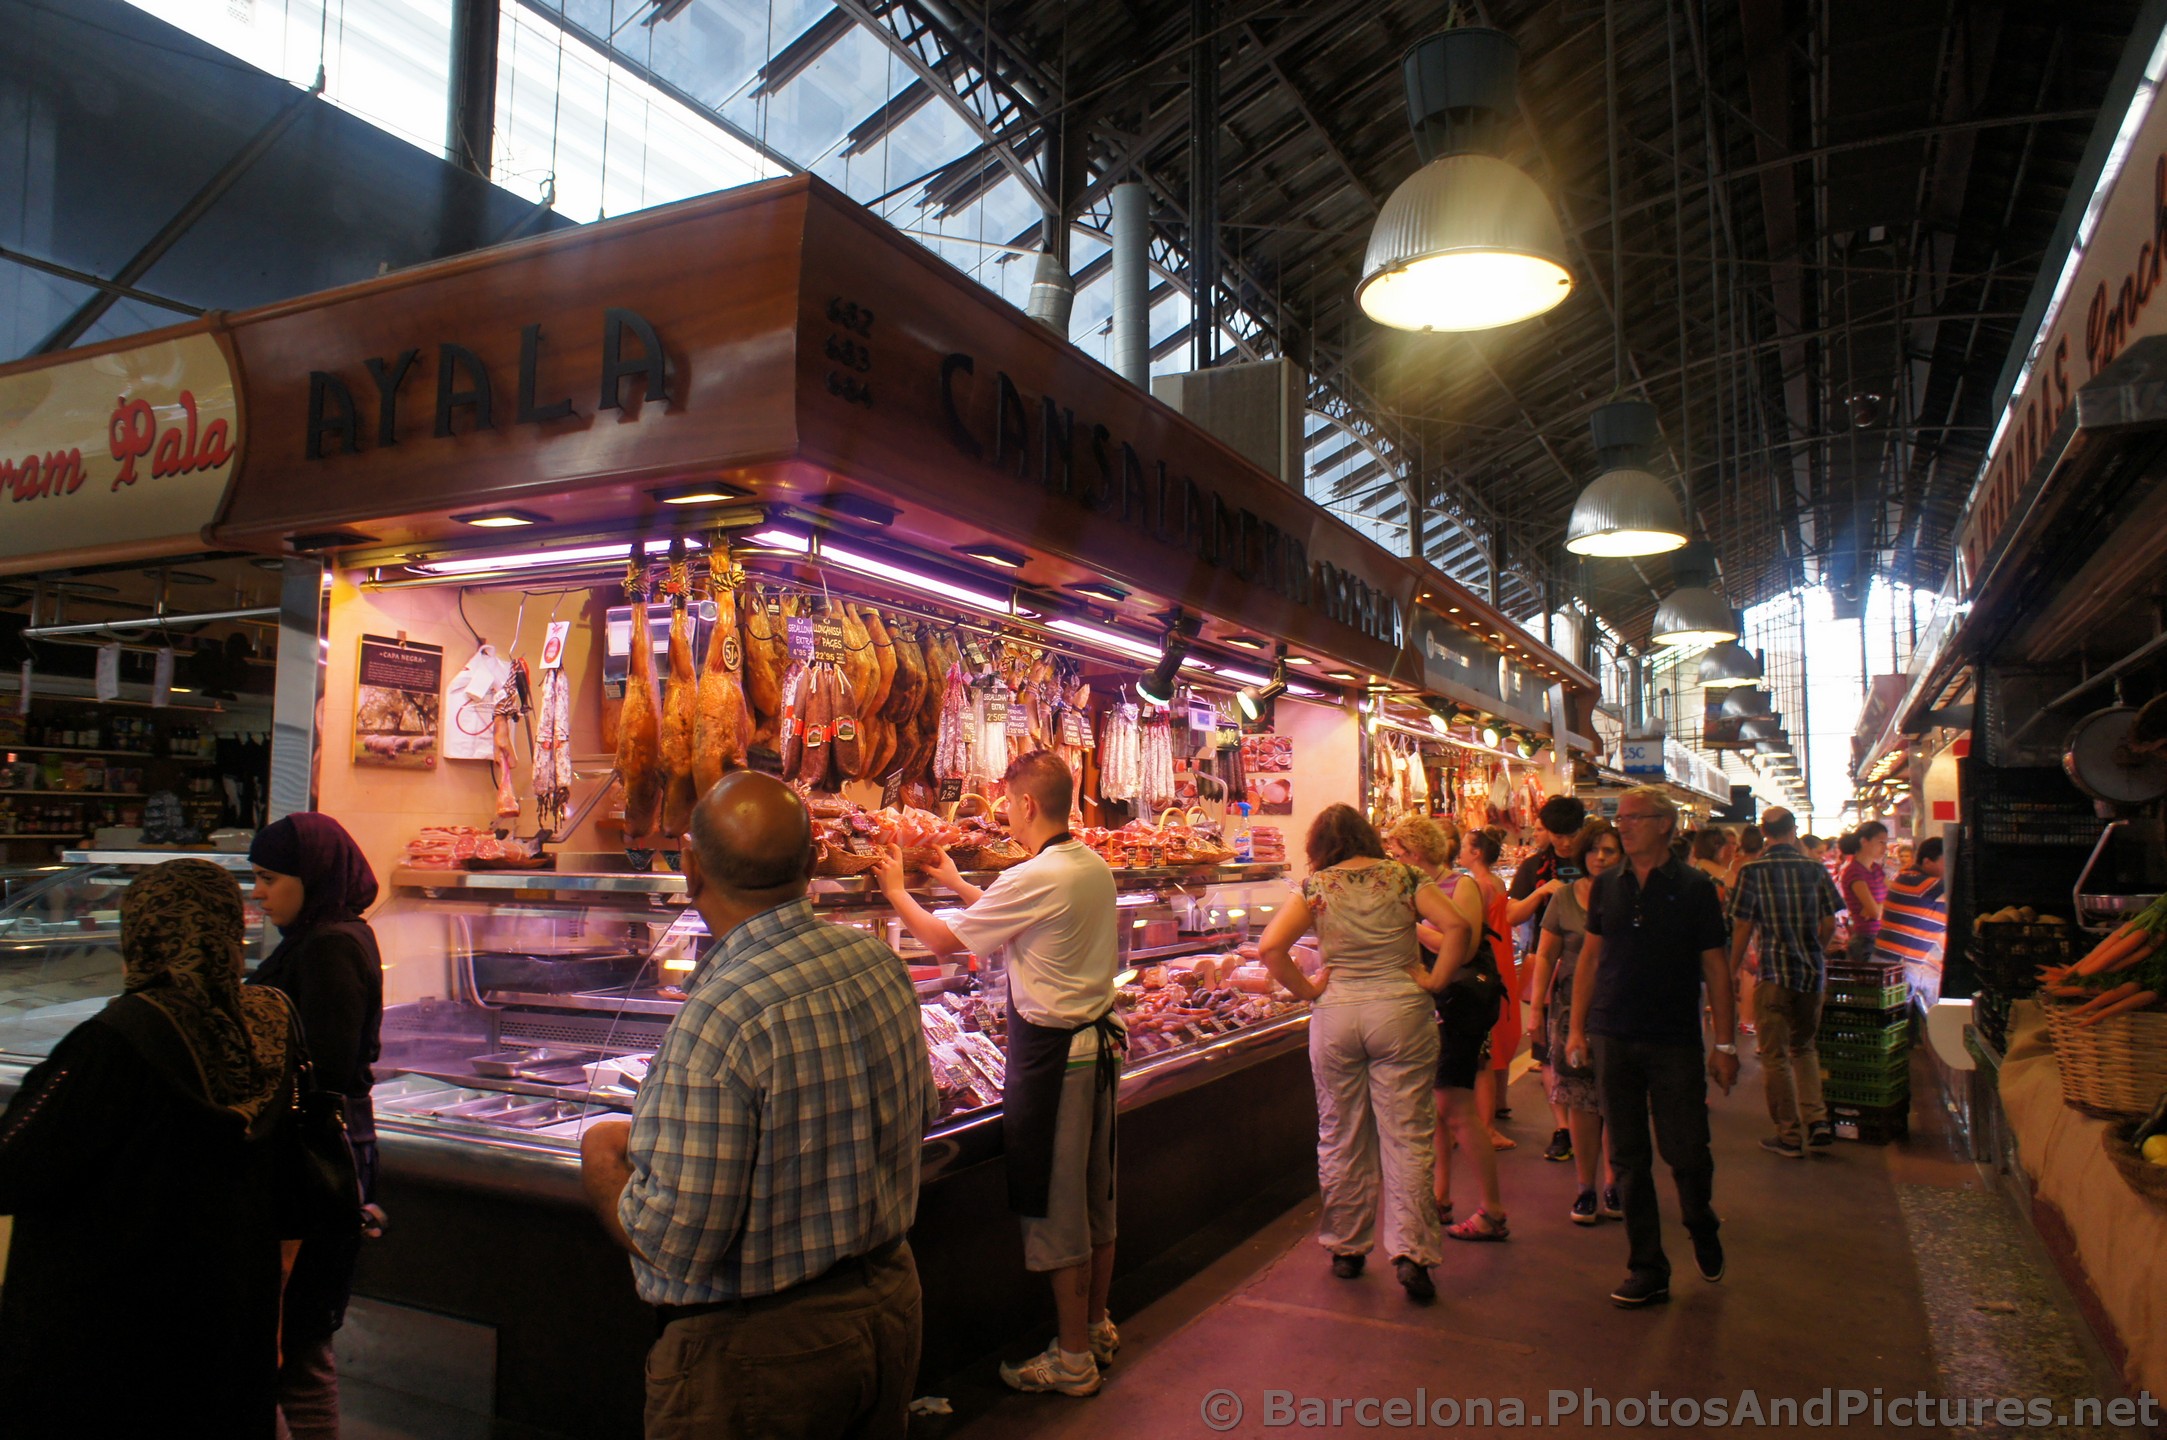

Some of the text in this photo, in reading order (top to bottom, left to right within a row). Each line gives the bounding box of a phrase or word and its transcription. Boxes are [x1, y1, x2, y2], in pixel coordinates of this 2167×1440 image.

[826, 295, 875, 338] 682
[824, 333, 872, 373] 683
[305, 307, 670, 460] AYALA
[826, 370, 875, 409] 684
[109, 389, 236, 492] Pala
[795, 635, 814, 646] EXTRA
